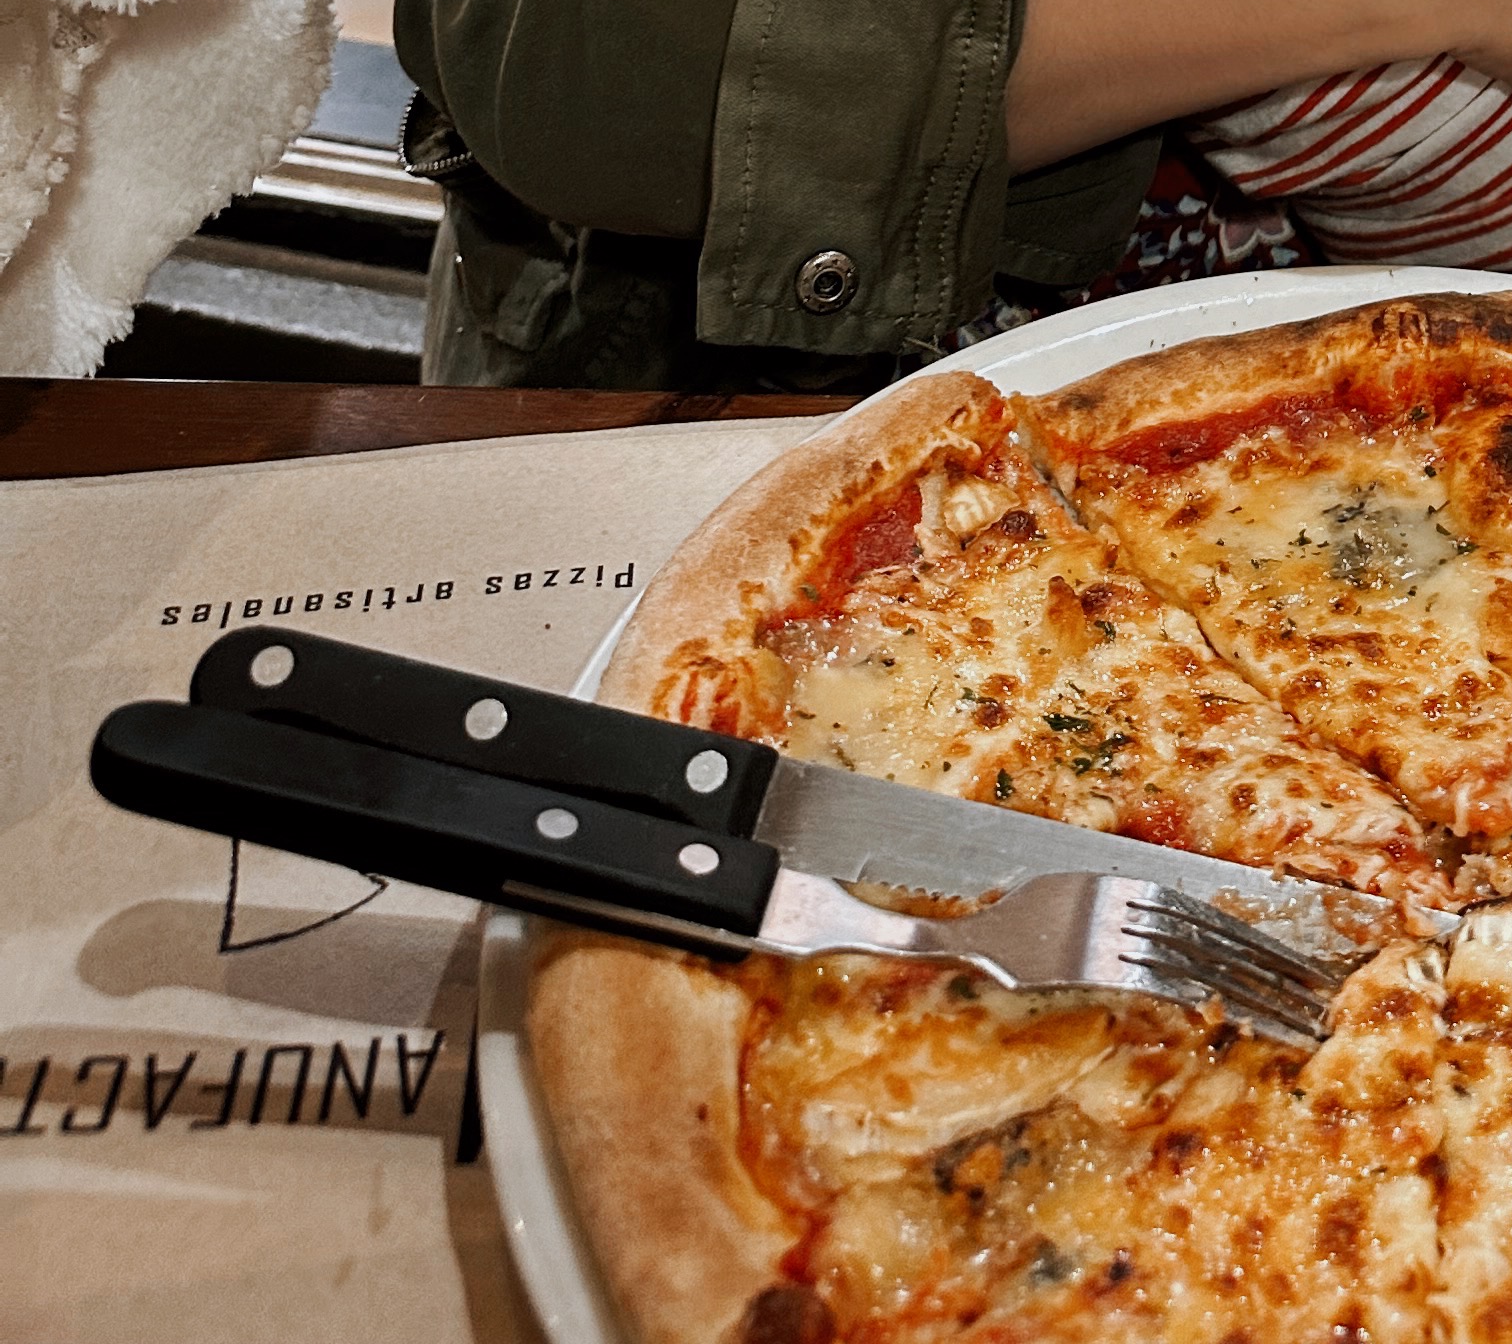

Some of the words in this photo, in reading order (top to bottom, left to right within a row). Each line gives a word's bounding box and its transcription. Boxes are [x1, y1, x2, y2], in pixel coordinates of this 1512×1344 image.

[485, 562, 635, 595] Pizzas
[161, 580, 455, 629] artisanales
[0, 1004, 485, 1165] ANUFACT
